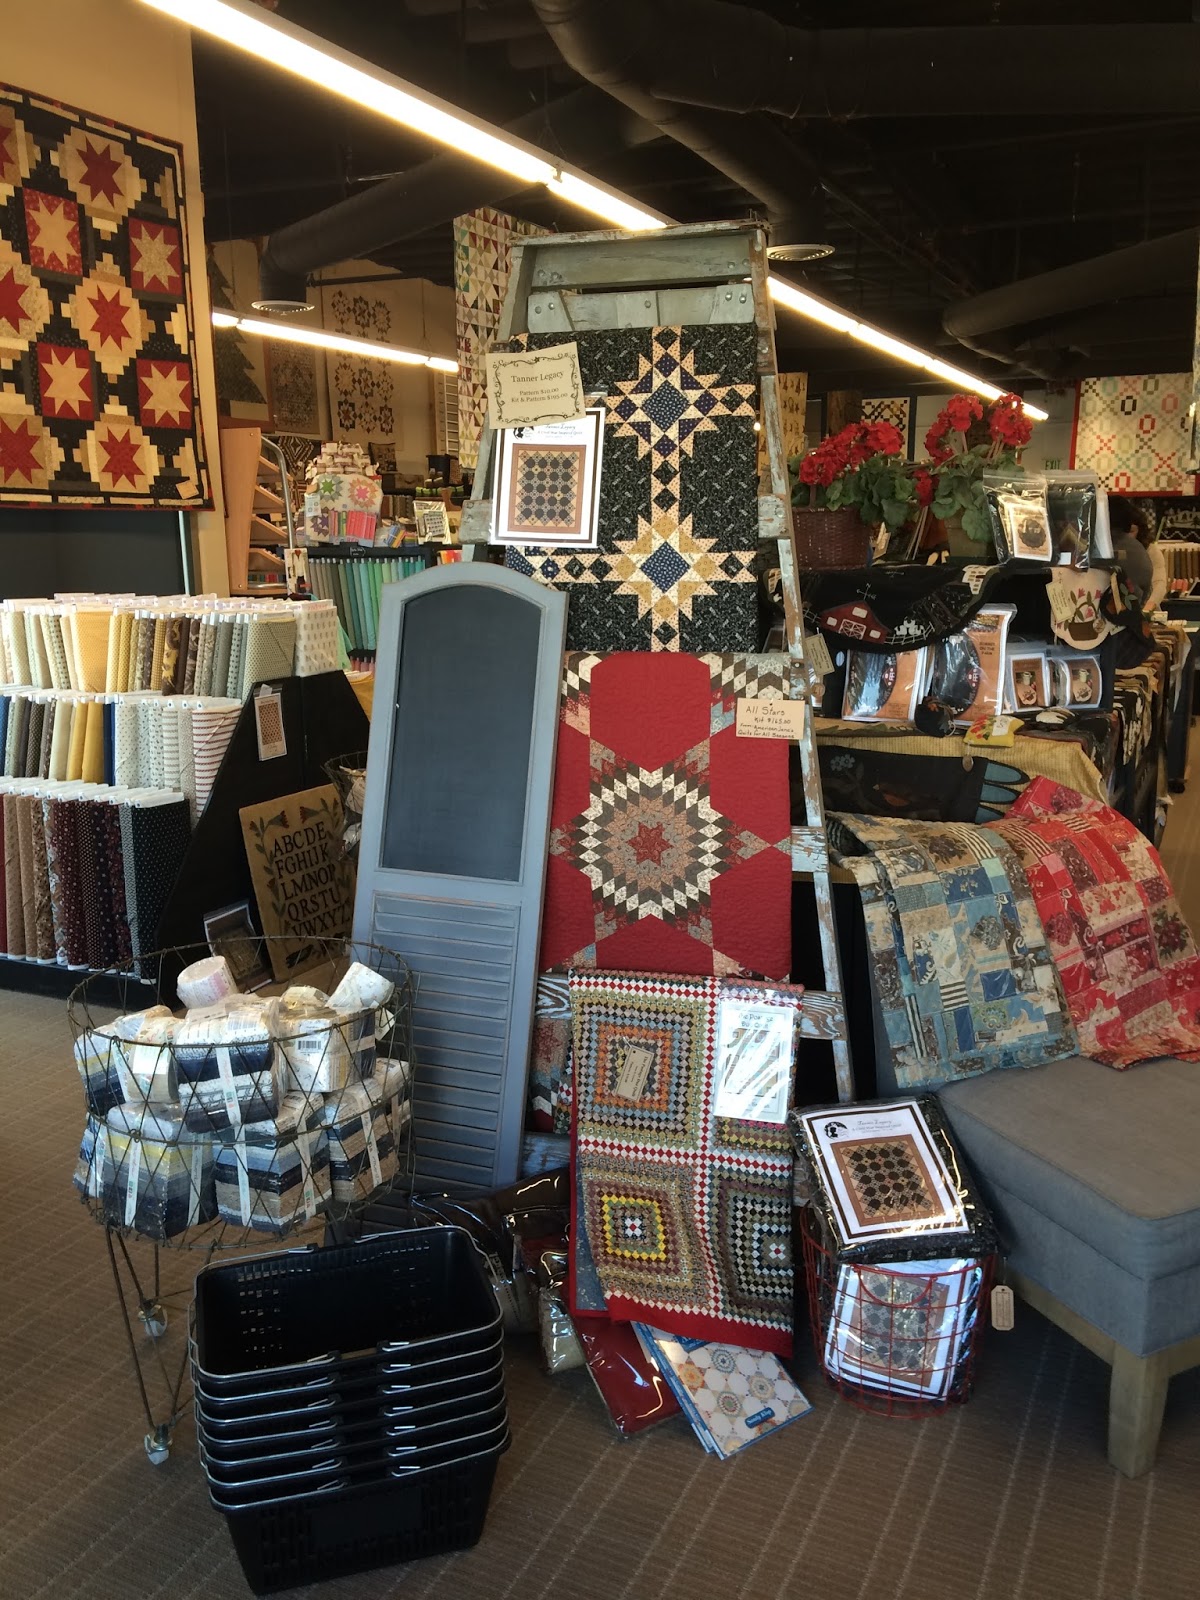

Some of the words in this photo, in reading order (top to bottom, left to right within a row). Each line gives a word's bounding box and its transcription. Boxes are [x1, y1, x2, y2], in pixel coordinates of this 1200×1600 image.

[540, 371, 564, 380] Legacy
[1045, 460, 1061, 470] EXIT
[762, 706, 785, 716] Stars
[274, 821, 327, 858] ABCDE
[275, 842, 330, 880] FGHIJK
[281, 863, 336, 900] LMNOP
[288, 887, 343, 922] QRSTU
